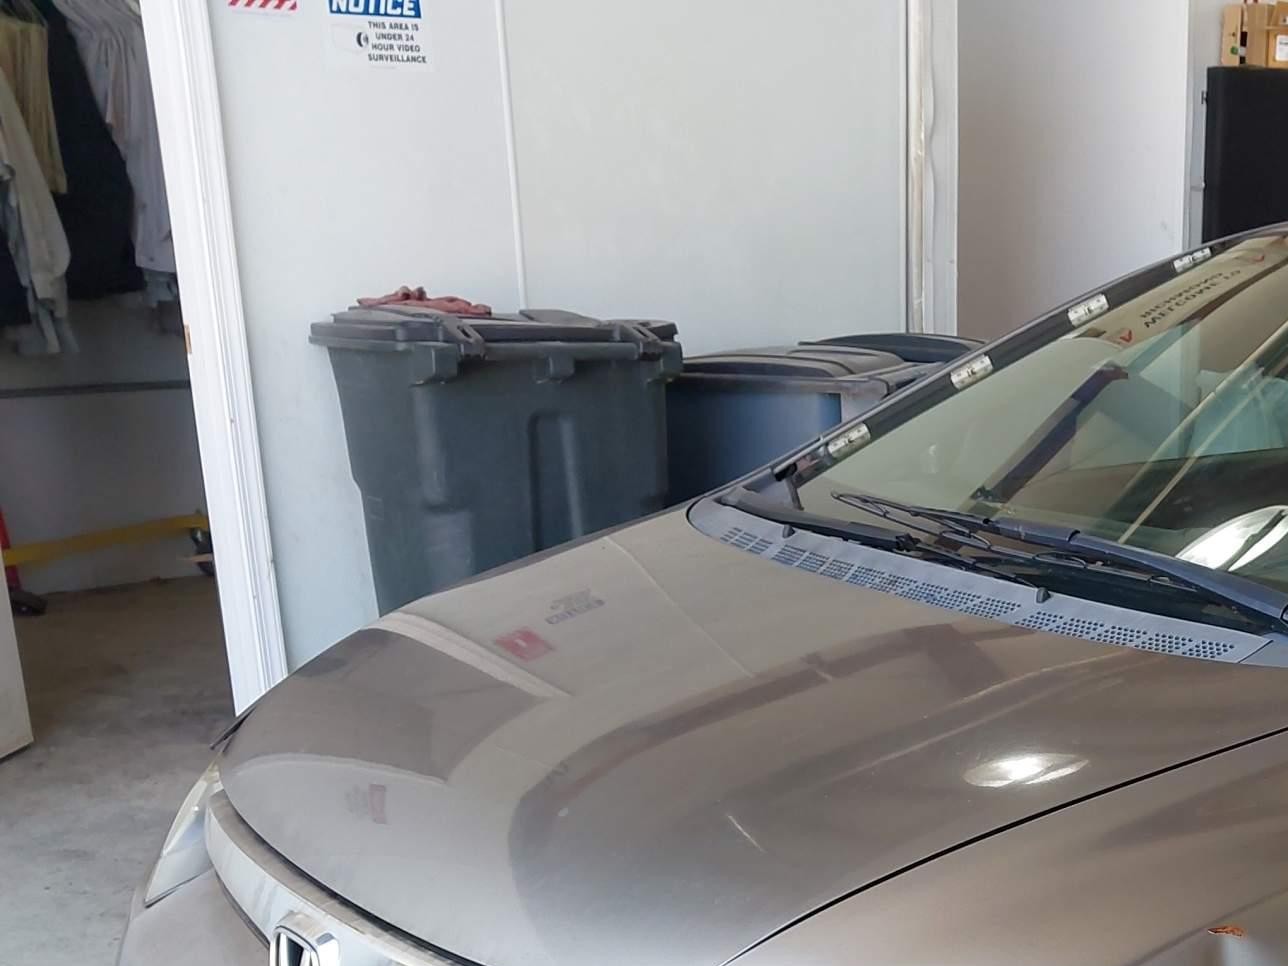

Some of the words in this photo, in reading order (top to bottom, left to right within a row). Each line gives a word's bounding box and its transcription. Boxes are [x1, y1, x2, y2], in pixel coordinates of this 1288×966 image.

[331, 0, 416, 16] NOTICE
[368, 21, 386, 30] THIS
[388, 22, 409, 31] AREA
[411, 23, 419, 32] IS
[375, 32, 403, 41] UNDER
[405, 33, 415, 42] 24
[371, 43, 395, 51] HOUR
[396, 44, 421, 53] VIDEO
[368, 54, 427, 63] SURVEILLANCE
